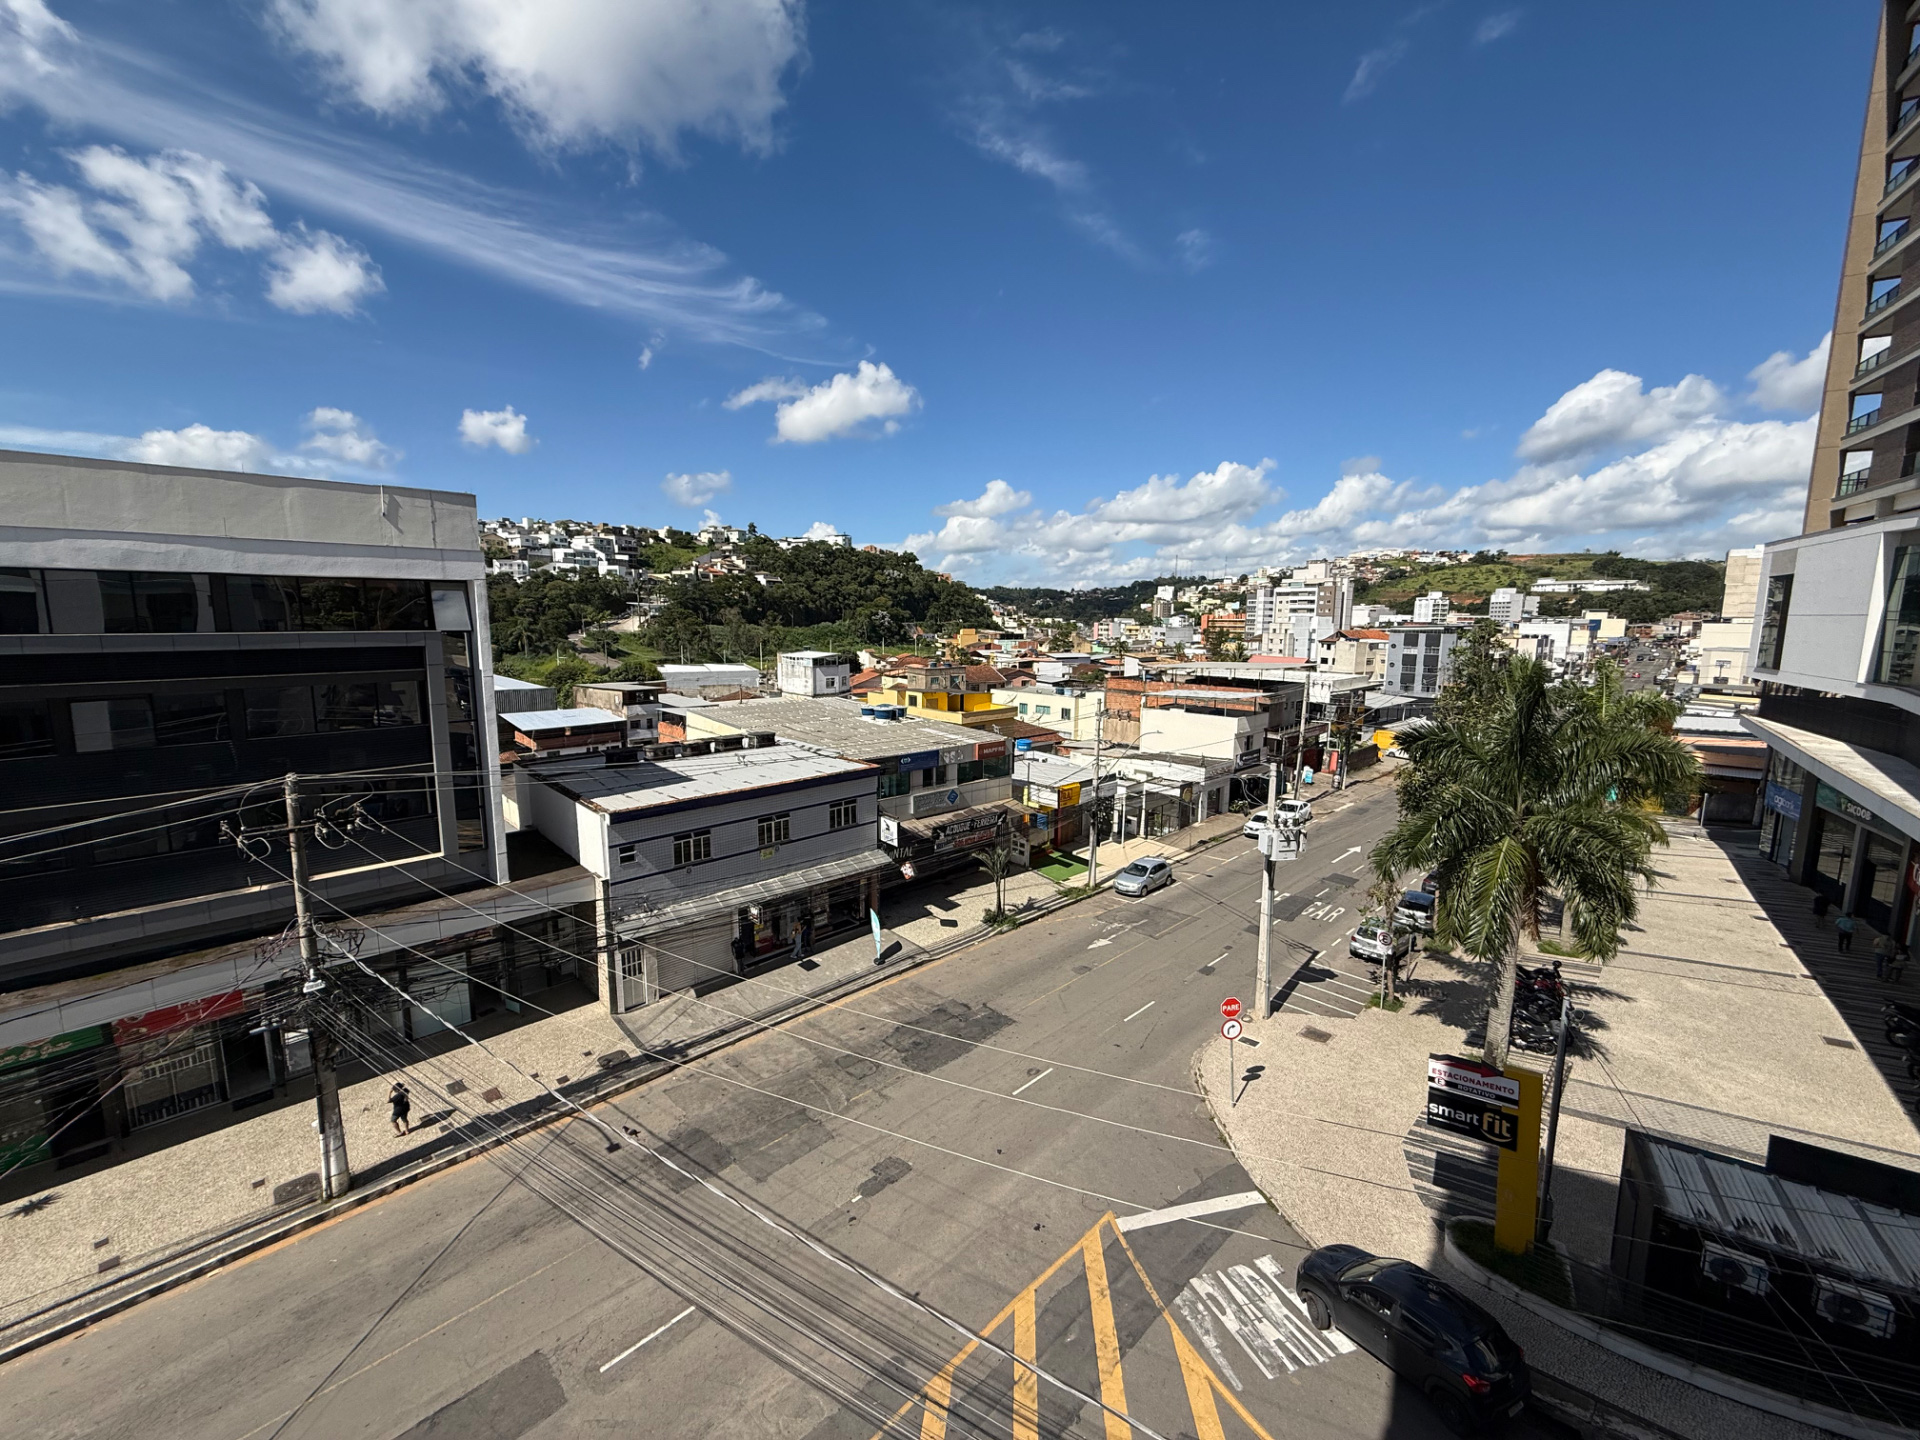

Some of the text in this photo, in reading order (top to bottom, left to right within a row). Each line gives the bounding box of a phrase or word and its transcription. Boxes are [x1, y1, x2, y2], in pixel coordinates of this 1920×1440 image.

[983, 746, 1005, 754] MAPFRE
[1847, 802, 1872, 820] SICOOB
[1432, 1067, 1515, 1095] ESTACIONAMENTO
[1457, 1084, 1496, 1099] ROTATIVO
[1429, 1103, 1479, 1126] smart
[1482, 1112, 1511, 1138] fit
